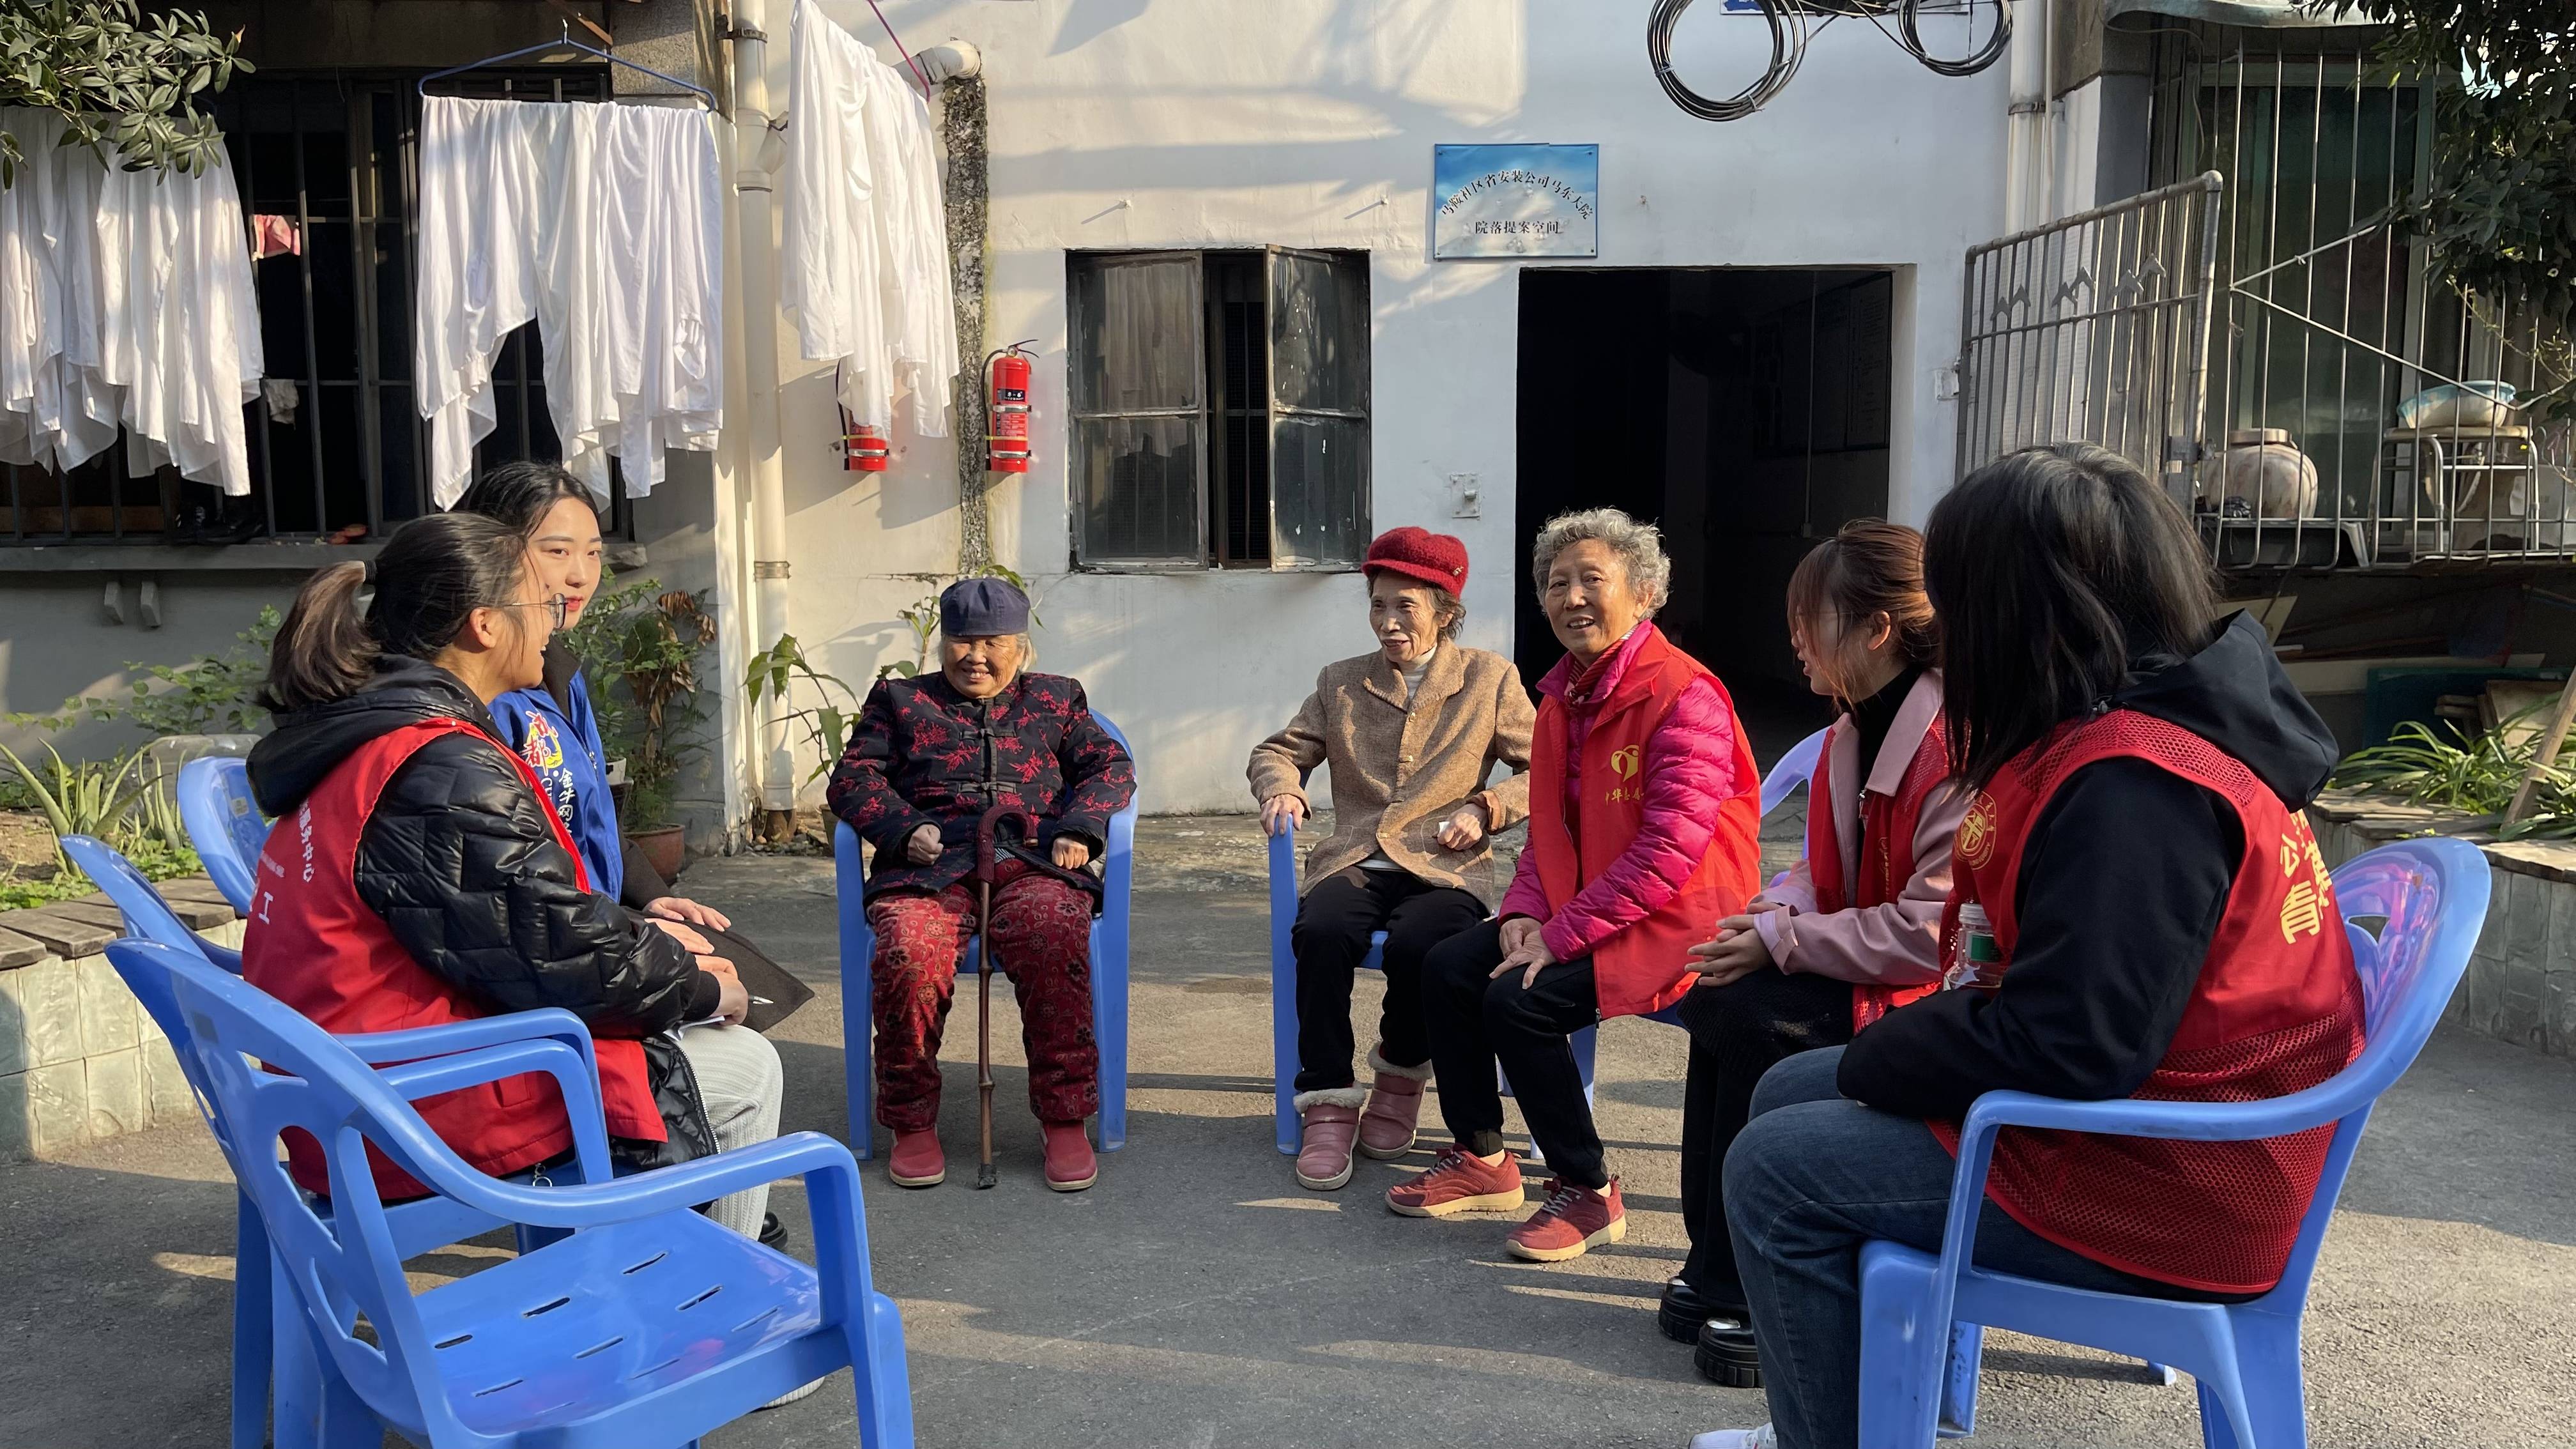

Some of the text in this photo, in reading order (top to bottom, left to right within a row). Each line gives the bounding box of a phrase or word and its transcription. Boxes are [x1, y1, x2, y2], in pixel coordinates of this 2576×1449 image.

[1475, 220, 1559, 234] 院落提案空间
